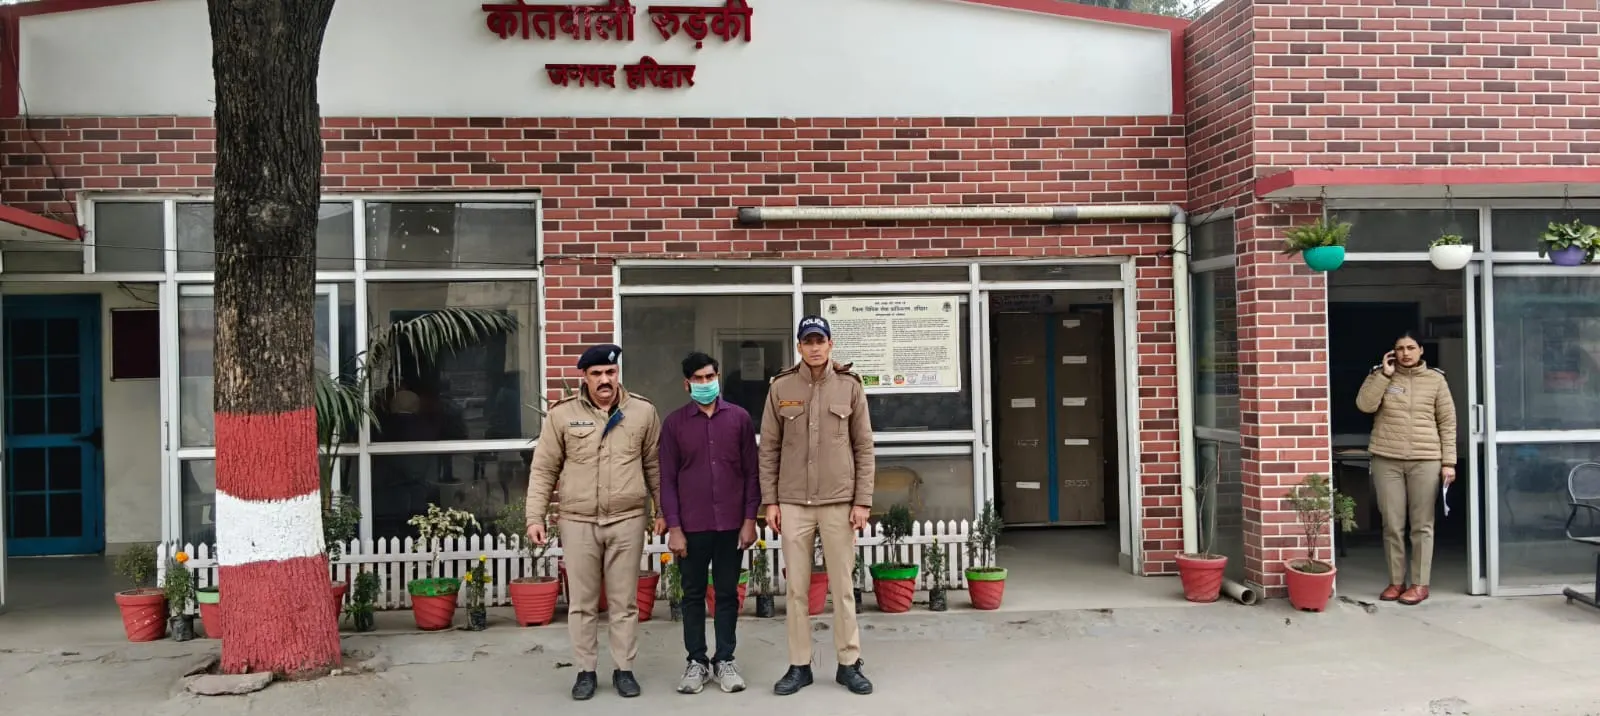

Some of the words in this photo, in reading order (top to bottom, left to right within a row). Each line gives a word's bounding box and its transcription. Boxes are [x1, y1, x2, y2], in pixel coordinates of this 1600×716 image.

[481, 0, 636, 41] कोतवाली
[648, 0, 753, 49] रुड़की
[545, 63, 617, 88] जनपद
[623, 55, 696, 89] हरिद्वार
[802, 318, 825, 328] POLICE
